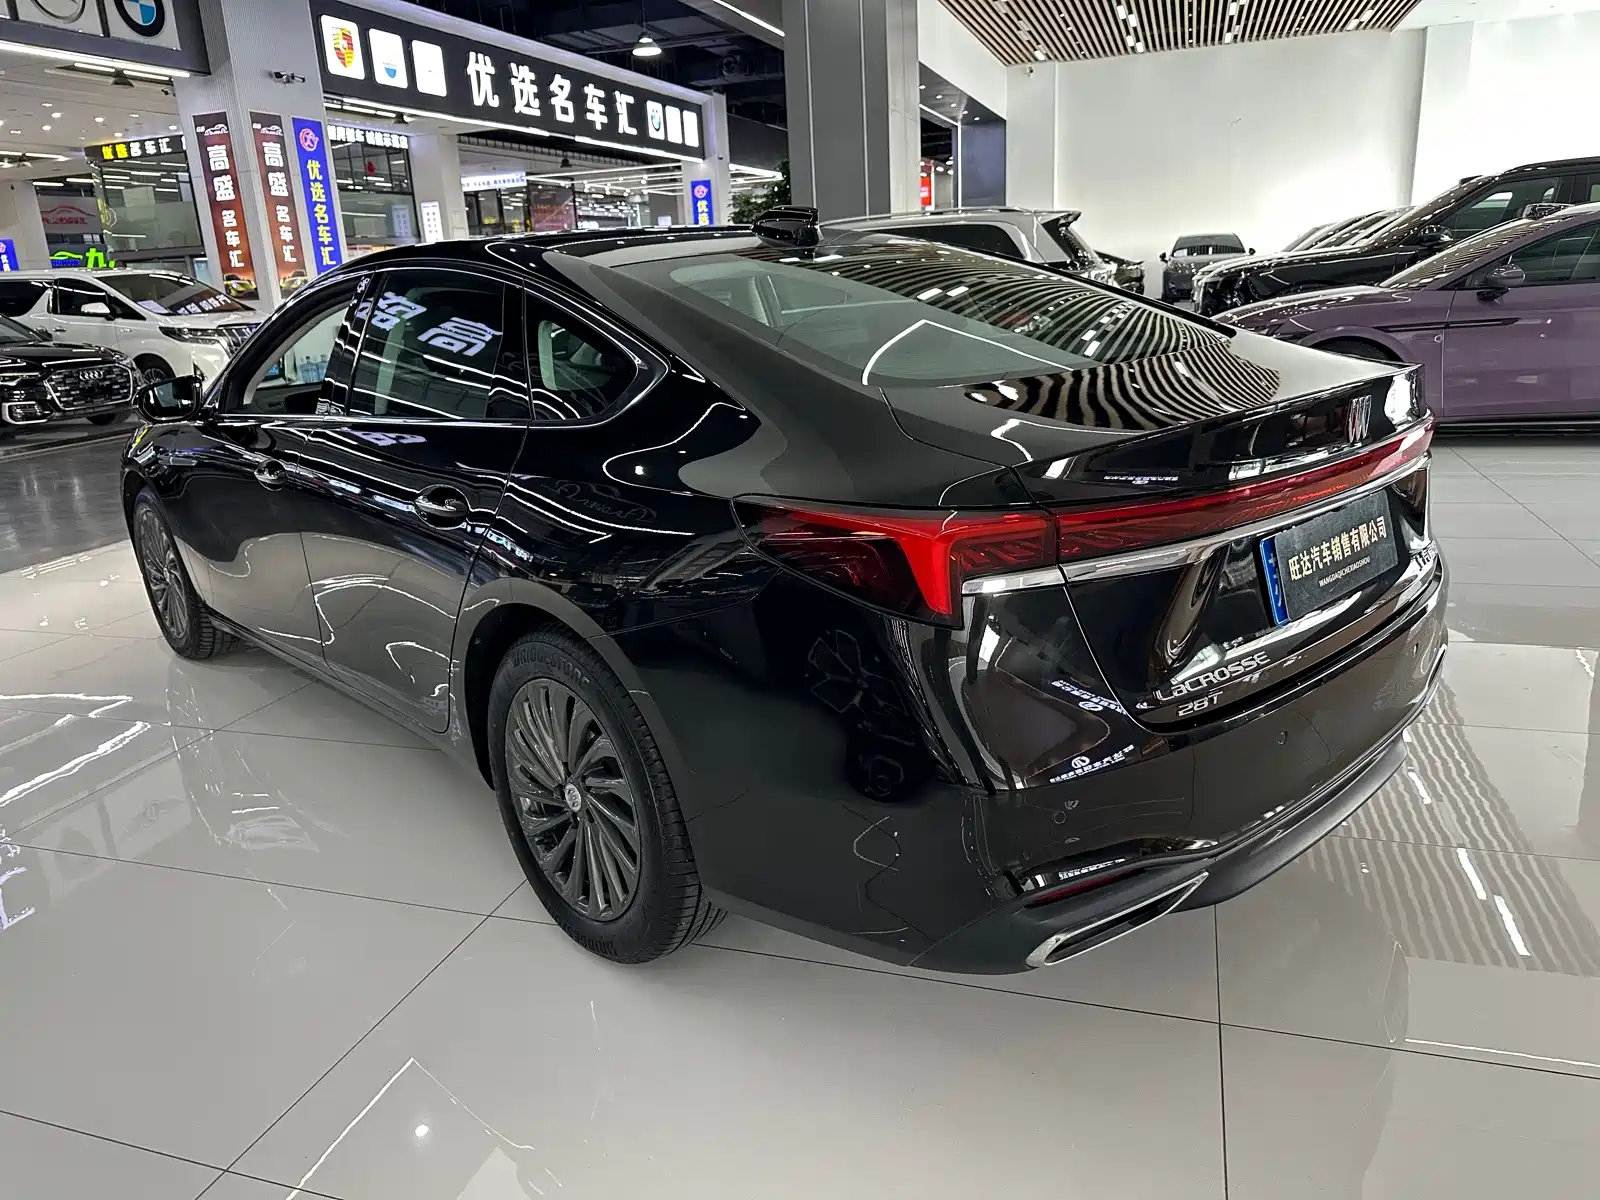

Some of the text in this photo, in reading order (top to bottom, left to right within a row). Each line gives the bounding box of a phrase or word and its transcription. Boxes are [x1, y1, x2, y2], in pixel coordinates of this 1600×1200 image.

[466, 51, 638, 136] 优选名车汇
[306, 159, 337, 266] 优选名车汇
[1288, 516, 1388, 581] 旺达汽车销售有限公司
[1318, 556, 1371, 587] WANGDAQICHEXIAOSHOU
[1177, 690, 1223, 717] 28T
